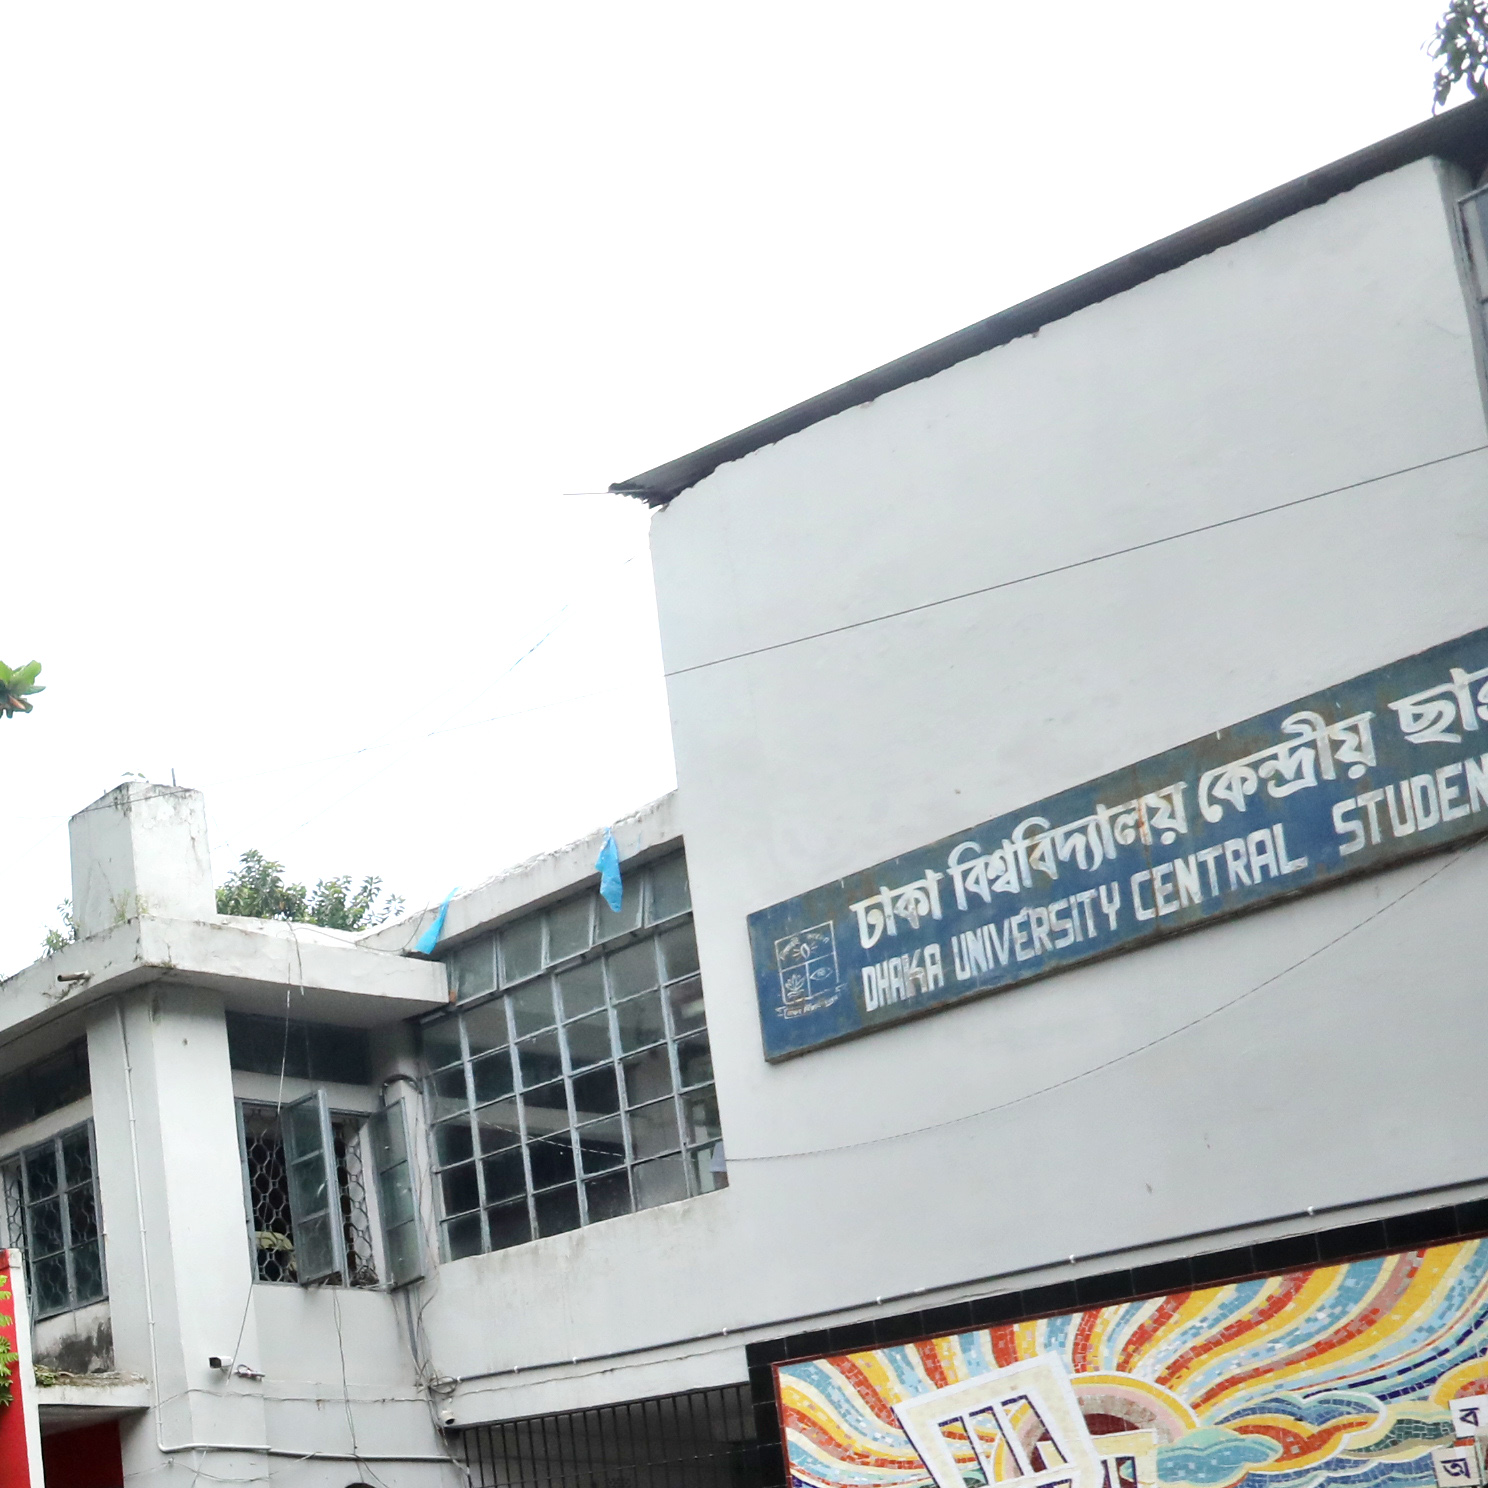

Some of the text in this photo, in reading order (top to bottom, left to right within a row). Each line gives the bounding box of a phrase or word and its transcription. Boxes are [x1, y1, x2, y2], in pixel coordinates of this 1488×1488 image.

[849, 868, 944, 949] ঢাকা
[946, 780, 1187, 911] বিশ্ববিদ্যালয়
[1198, 710, 1376, 823] কেন্দ্রীয়
[861, 942, 945, 1012] DHAKA
[951, 881, 1121, 981] UNIVERSITY
[1130, 823, 1308, 922] CENTRAL
